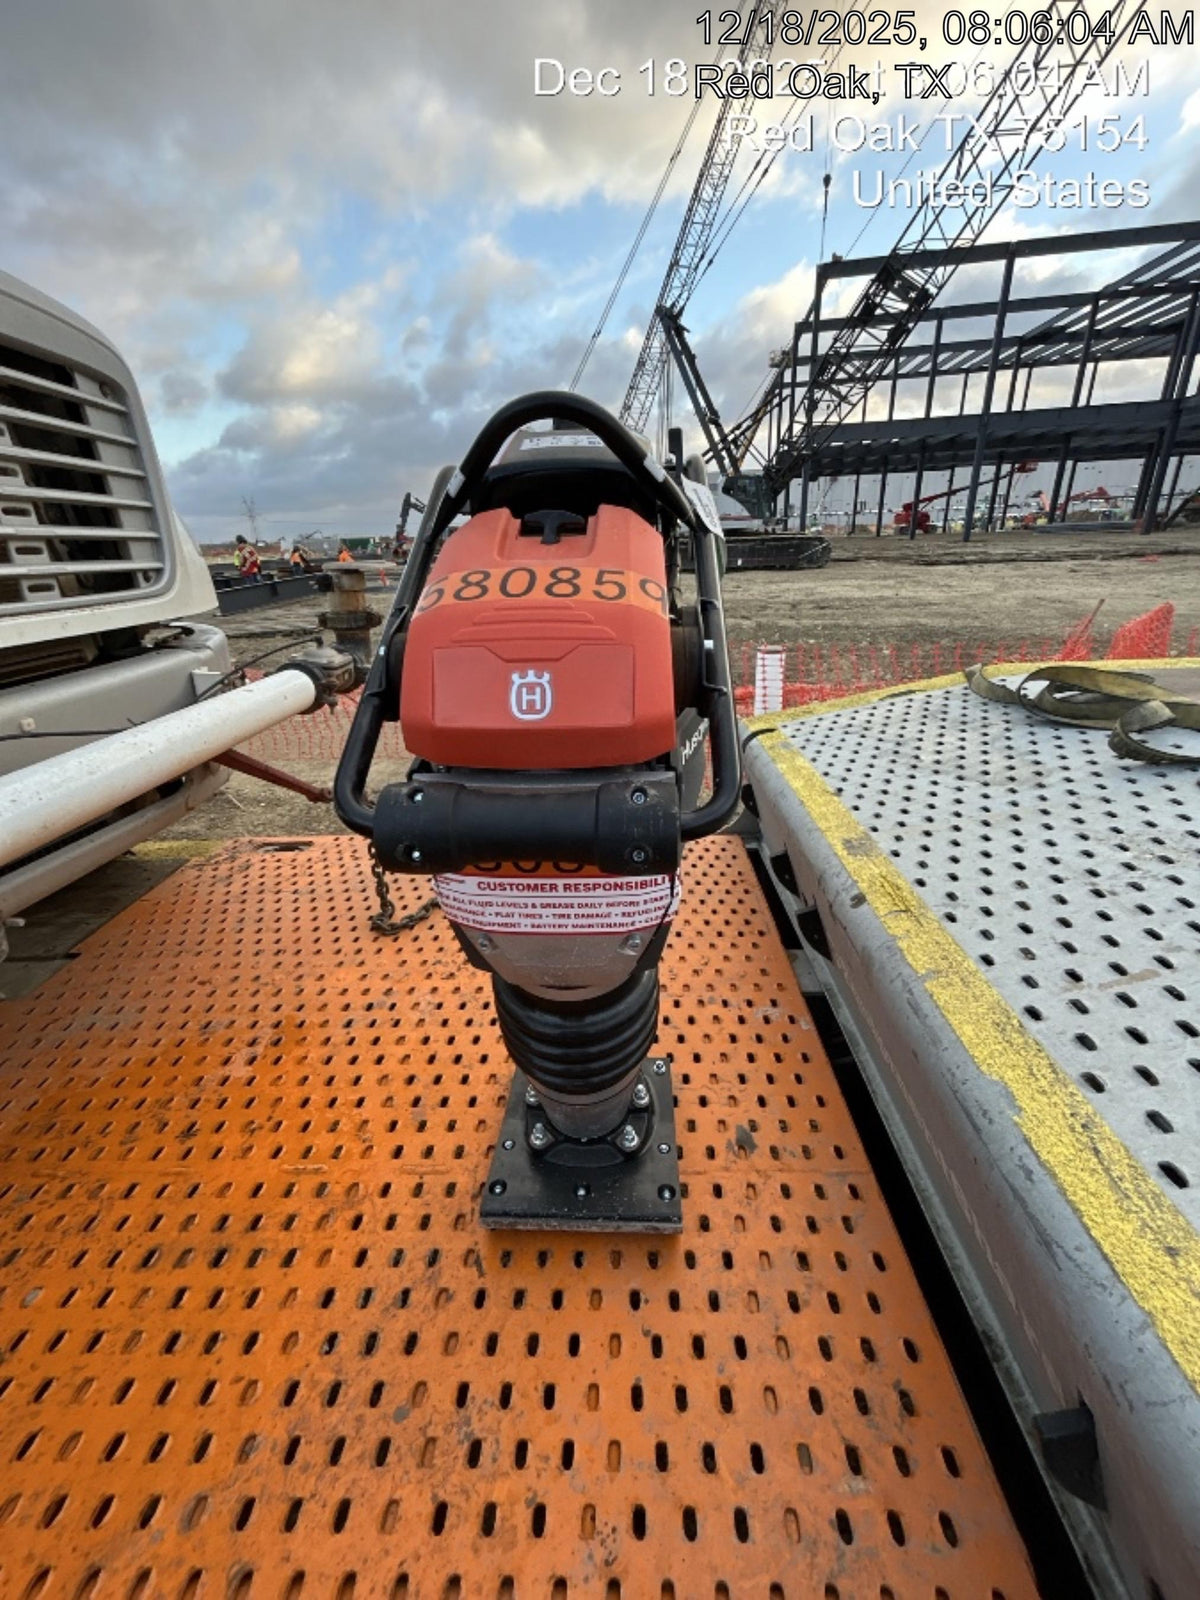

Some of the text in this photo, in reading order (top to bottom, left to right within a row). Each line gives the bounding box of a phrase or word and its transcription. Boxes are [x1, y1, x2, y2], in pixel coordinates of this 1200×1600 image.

[477, 881, 559, 893] CUSTOMER
[495, 901, 529, 909] LEVELS
[577, 902, 603, 910] DAILY
[606, 900, 640, 909] BEFORE
[573, 911, 612, 920] DAMAGE
[530, 922, 570, 930] BATTERY
